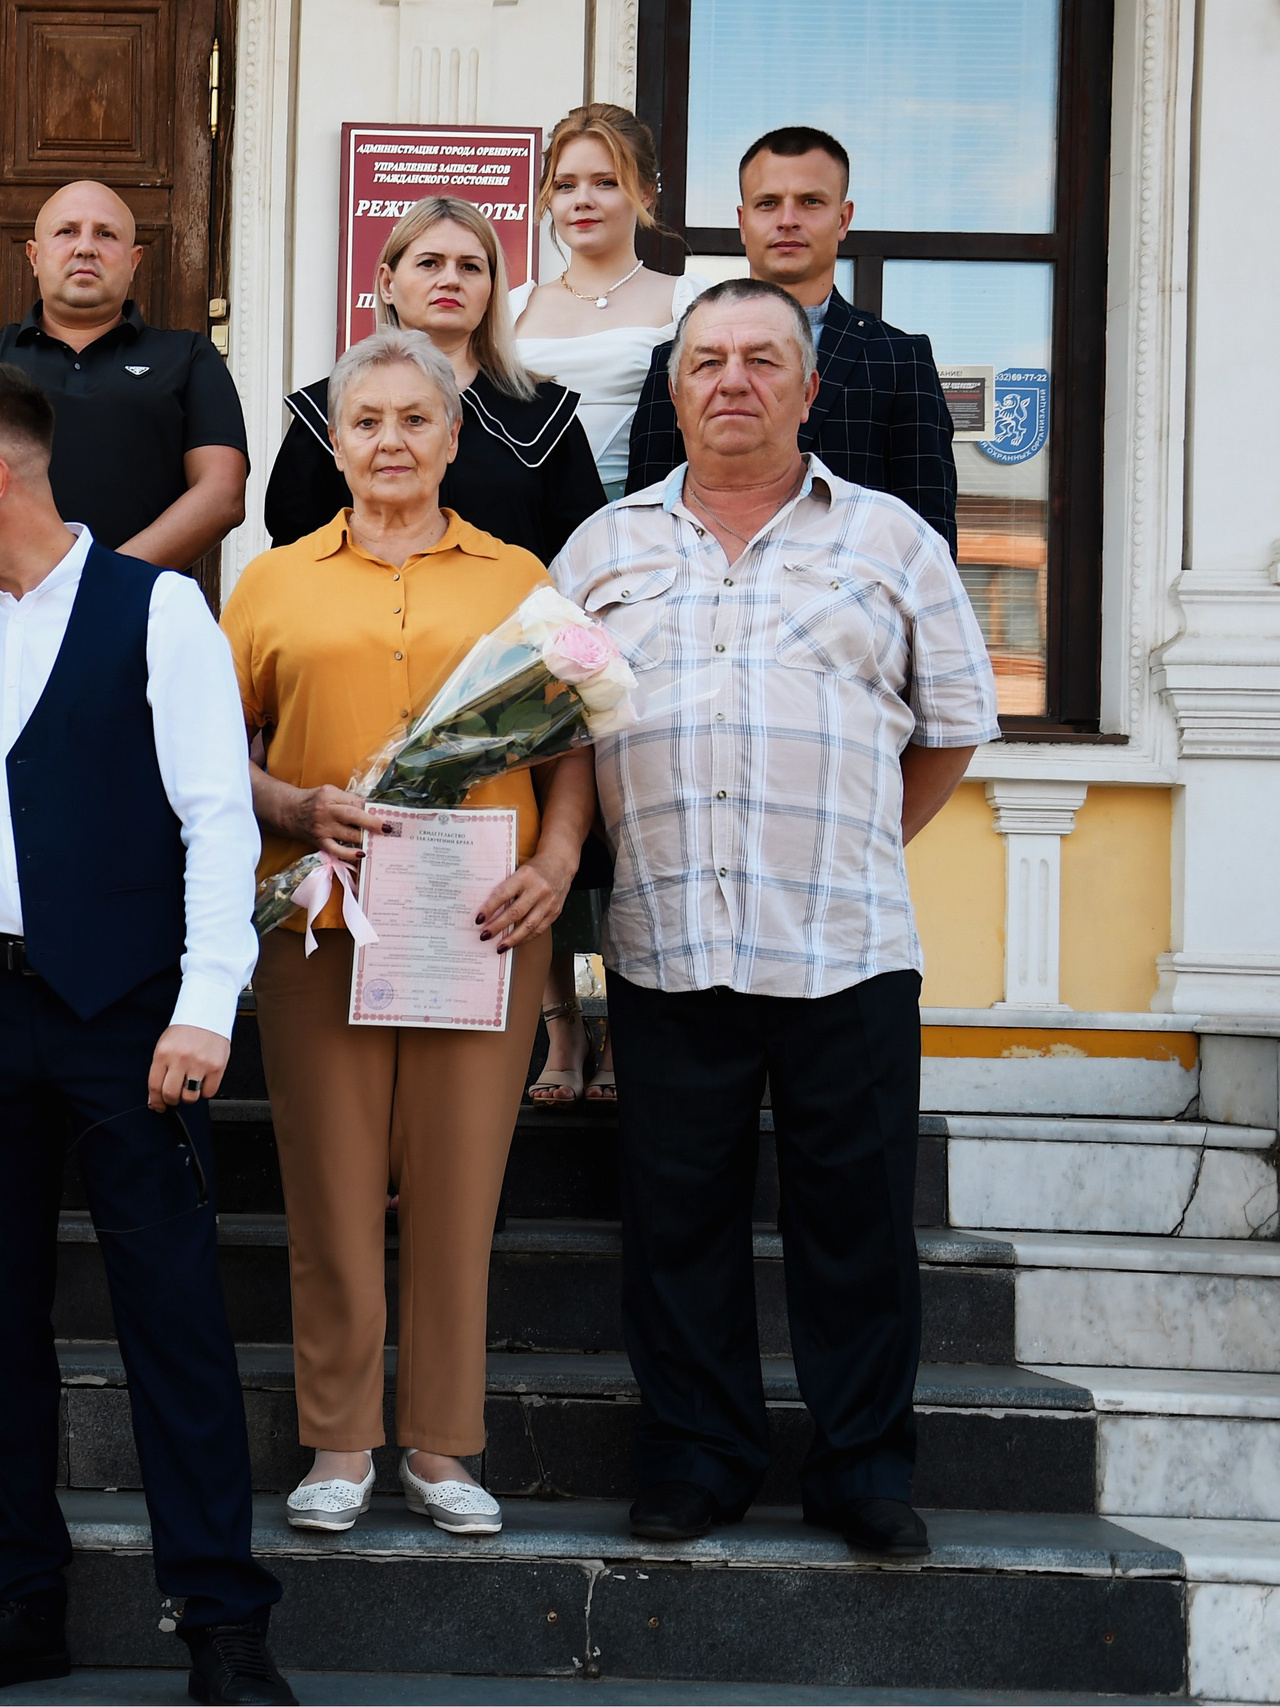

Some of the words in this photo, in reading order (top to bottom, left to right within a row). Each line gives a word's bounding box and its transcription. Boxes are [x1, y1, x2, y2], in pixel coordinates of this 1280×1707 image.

[356, 144, 439, 155] АДМИНИСТРАЦИЯ
[439, 146, 475, 157] ГОРОДА
[476, 147, 529, 158] ОРЕНБУРГА
[373, 162, 438, 173] УПРАВЛЕНИЕ
[438, 163, 478, 174] ЗАПИСИ
[478, 165, 511, 175] АКТОВ
[373, 173, 449, 185] ГРАЖДАНСКОГО
[450, 175, 510, 186] СОСТОЯНИЯ
[354, 199, 418, 218] РЕЖИ
[987, 447, 1031, 461] ОХРАННЫХ
